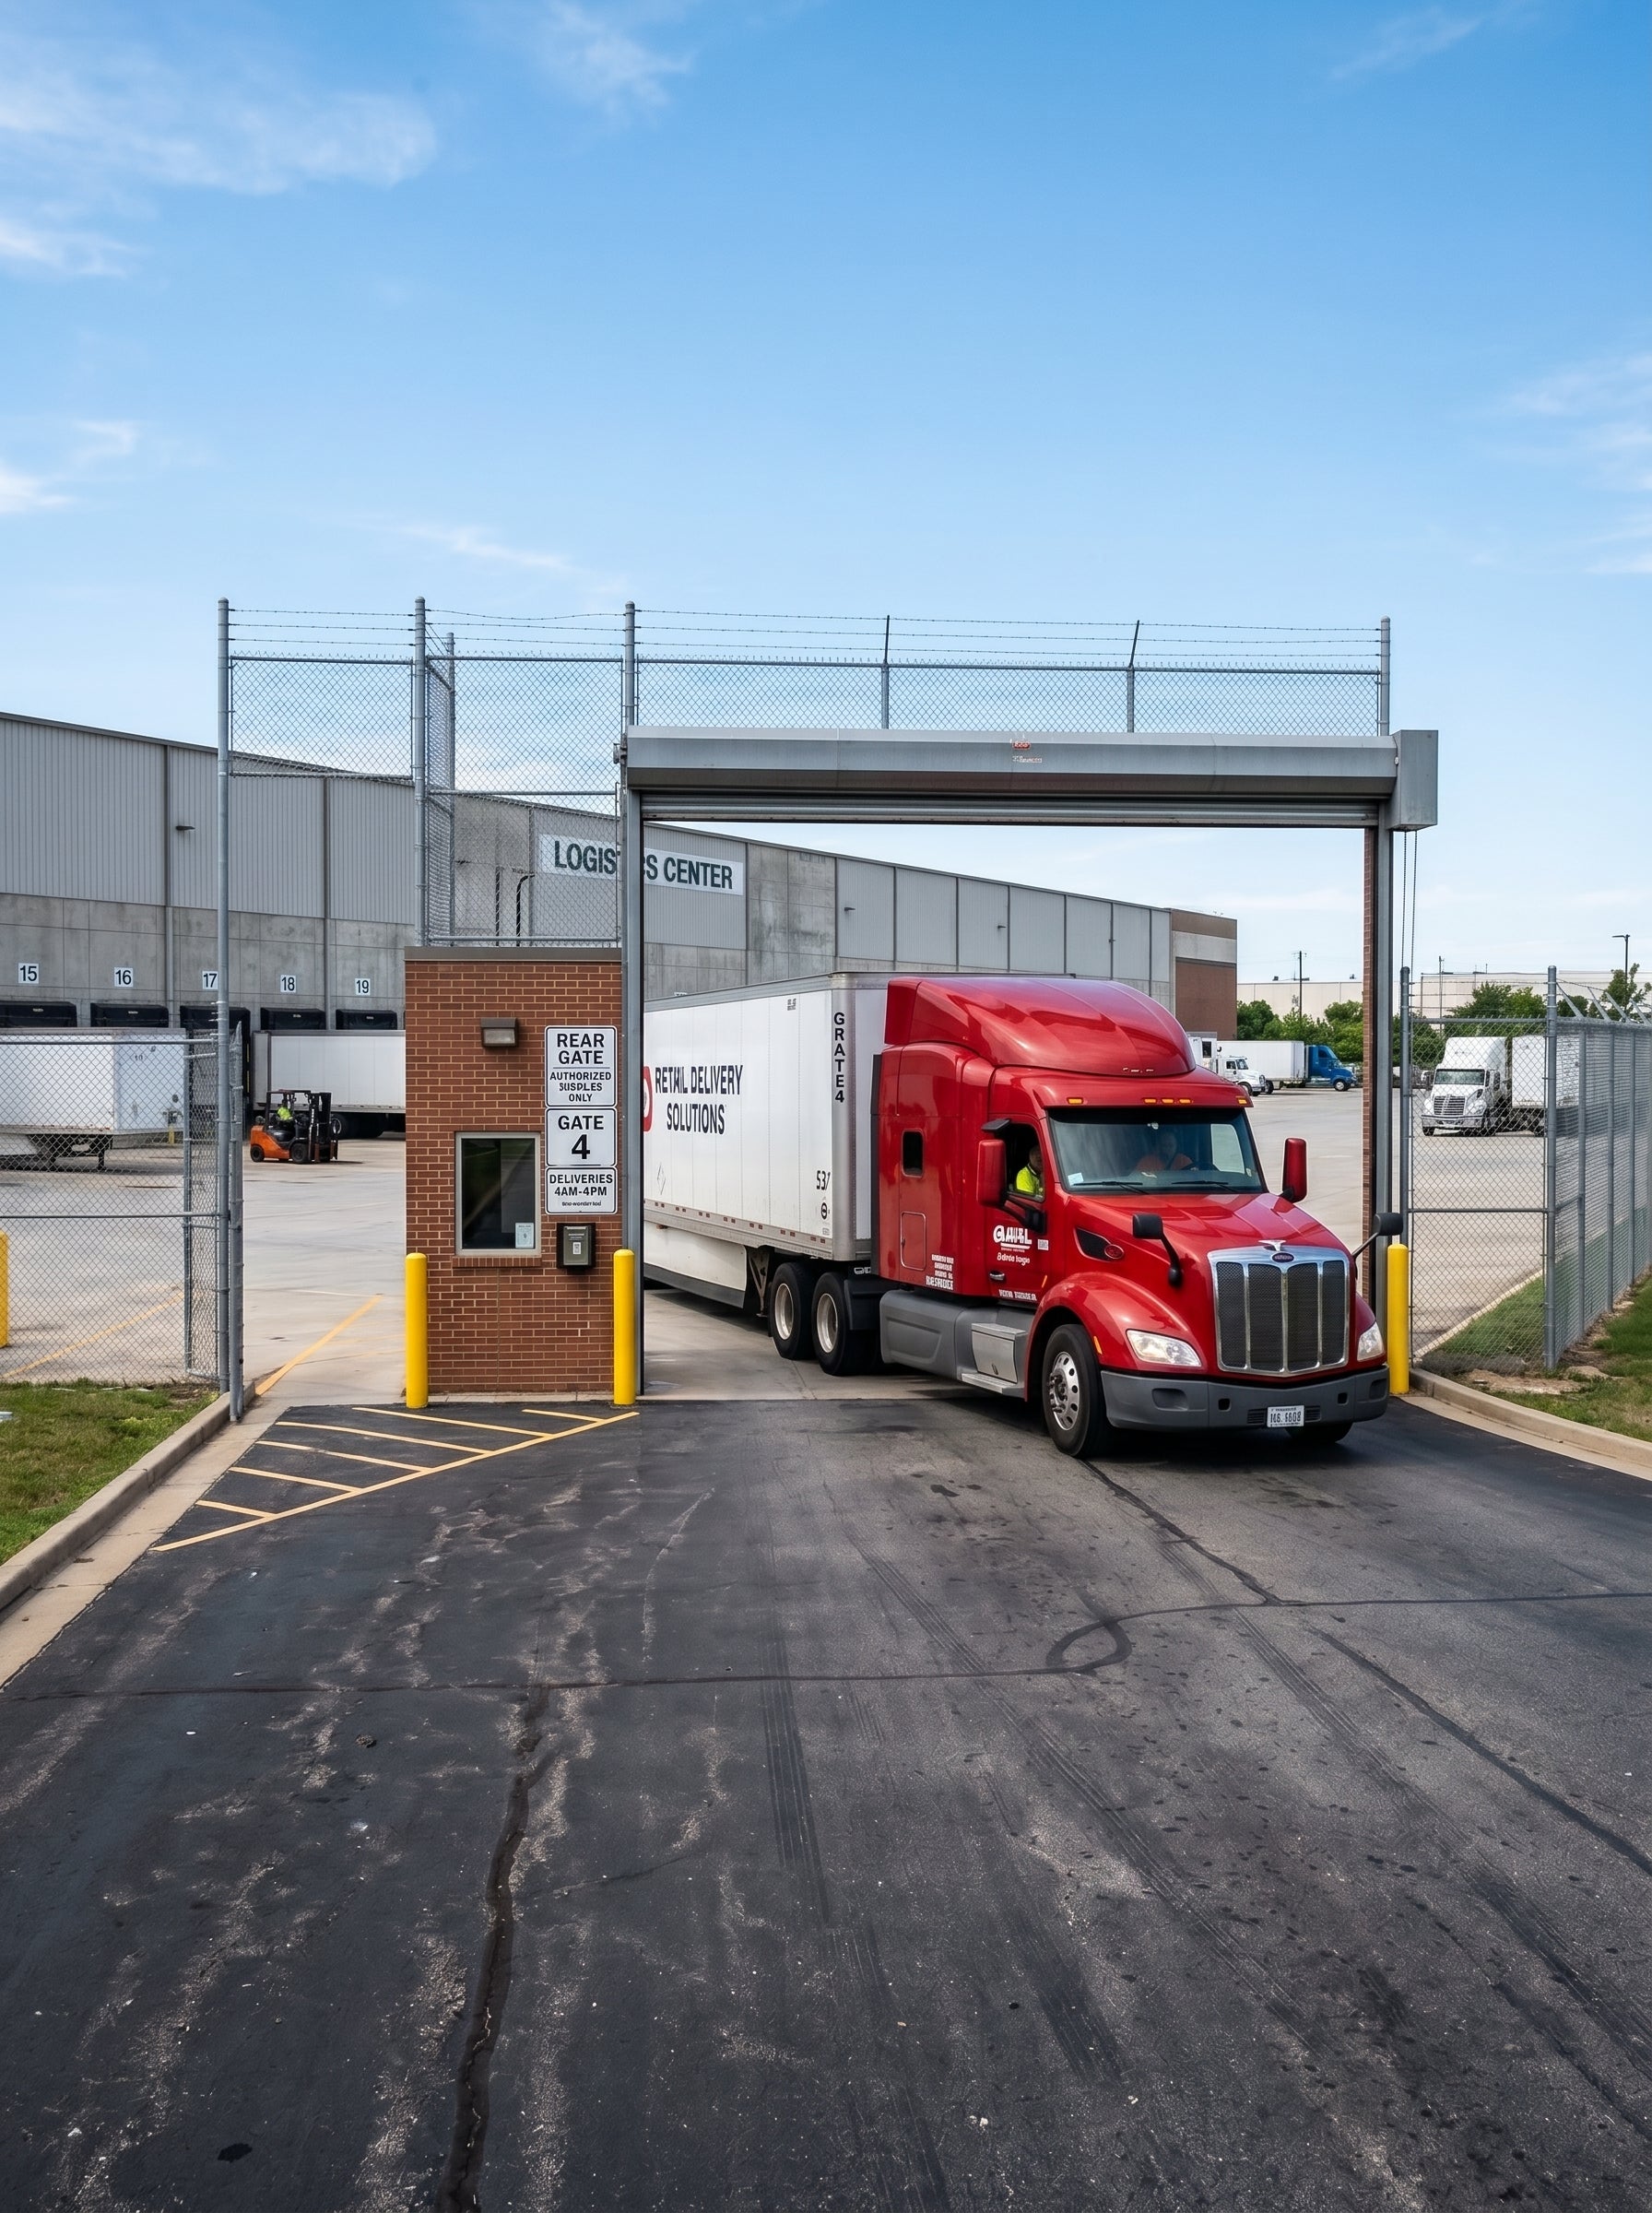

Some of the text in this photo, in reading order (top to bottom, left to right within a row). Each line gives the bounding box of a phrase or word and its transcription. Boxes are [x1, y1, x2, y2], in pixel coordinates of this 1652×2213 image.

[663, 857, 734, 890] CENTER
[19, 965, 38, 982] 15
[115, 969, 133, 985] 16
[203, 973, 218, 988] 17
[280, 976, 295, 992] 18
[356, 979, 370, 994] 19
[557, 1033, 605, 1048] REAR
[558, 1050, 604, 1065] GATE
[549, 1071, 612, 1081] AUTHORIZED
[690, 1064, 743, 1095] DELIVERY
[568, 1093, 593, 1103] ONLY
[558, 1115, 604, 1130] GATE
[667, 1102, 726, 1135] SOLUTIONS
[571, 1134, 591, 1160] 4
[549, 1173, 613, 1184] DELIVERIES
[553, 1186, 608, 1196] 4AM-4PM
